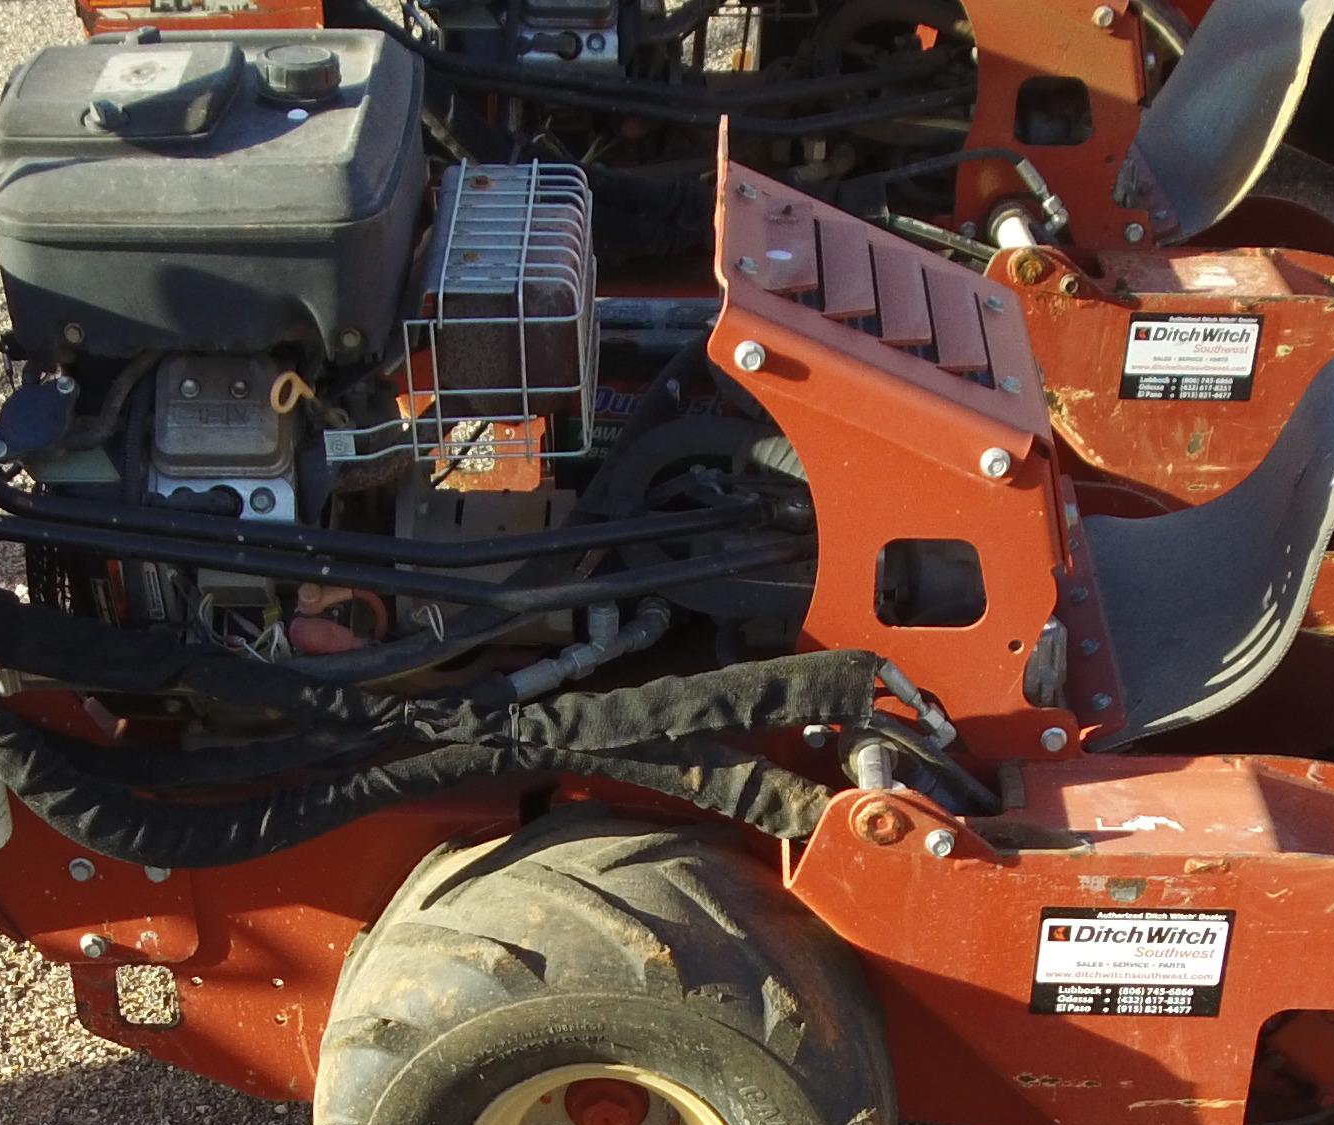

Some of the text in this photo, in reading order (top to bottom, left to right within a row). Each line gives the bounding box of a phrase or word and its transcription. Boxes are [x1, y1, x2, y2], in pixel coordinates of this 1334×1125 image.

[1135, 947, 1215, 959] Southwest
[1058, 986, 1101, 995] Lubbock
[1057, 995, 1094, 1004] Odessa
[1068, 1004, 1091, 1013] Paso
